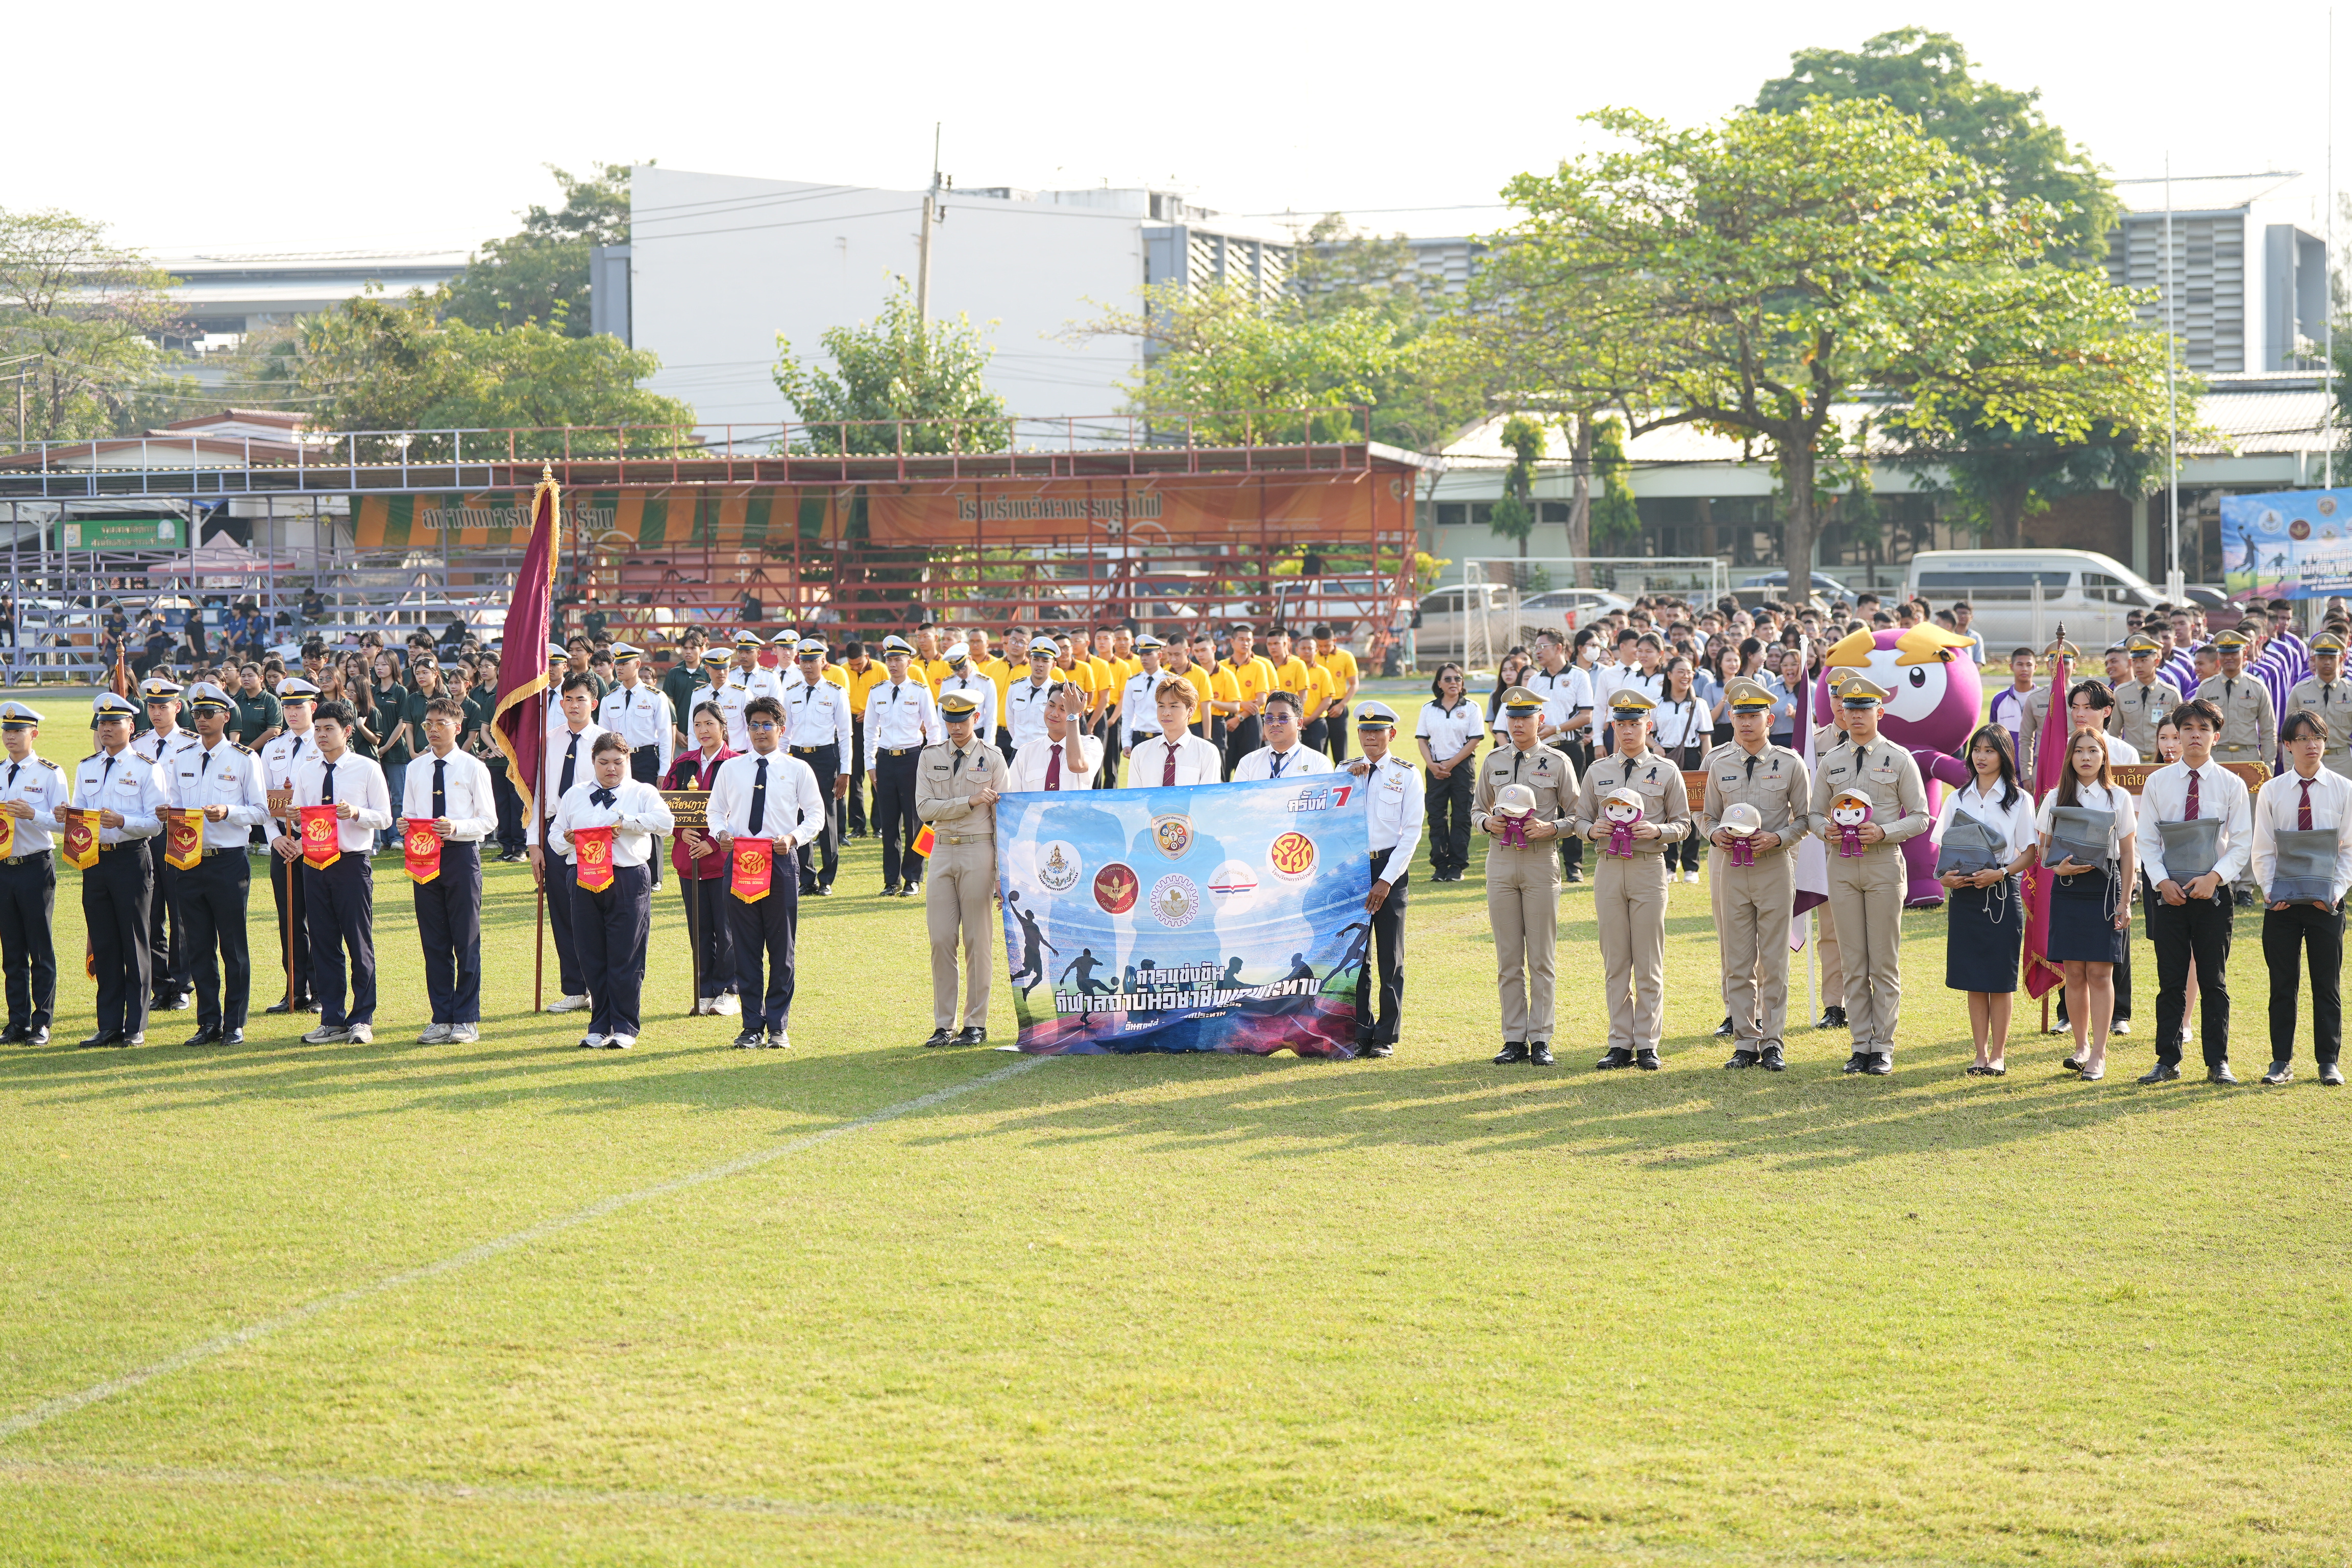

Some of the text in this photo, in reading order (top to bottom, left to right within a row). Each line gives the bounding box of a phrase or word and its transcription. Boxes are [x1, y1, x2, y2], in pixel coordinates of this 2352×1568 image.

[1287, 786, 1353, 812] ครั้งที่ 7
[1038, 872, 1079, 891] วิทยาลัยการชลประทาน
[1271, 864, 1317, 882] โรงเรียนการไปรษณีย์
[1161, 911, 1171, 920] ELECTRIC
[1136, 962, 1226, 985] การแข่งขัน
